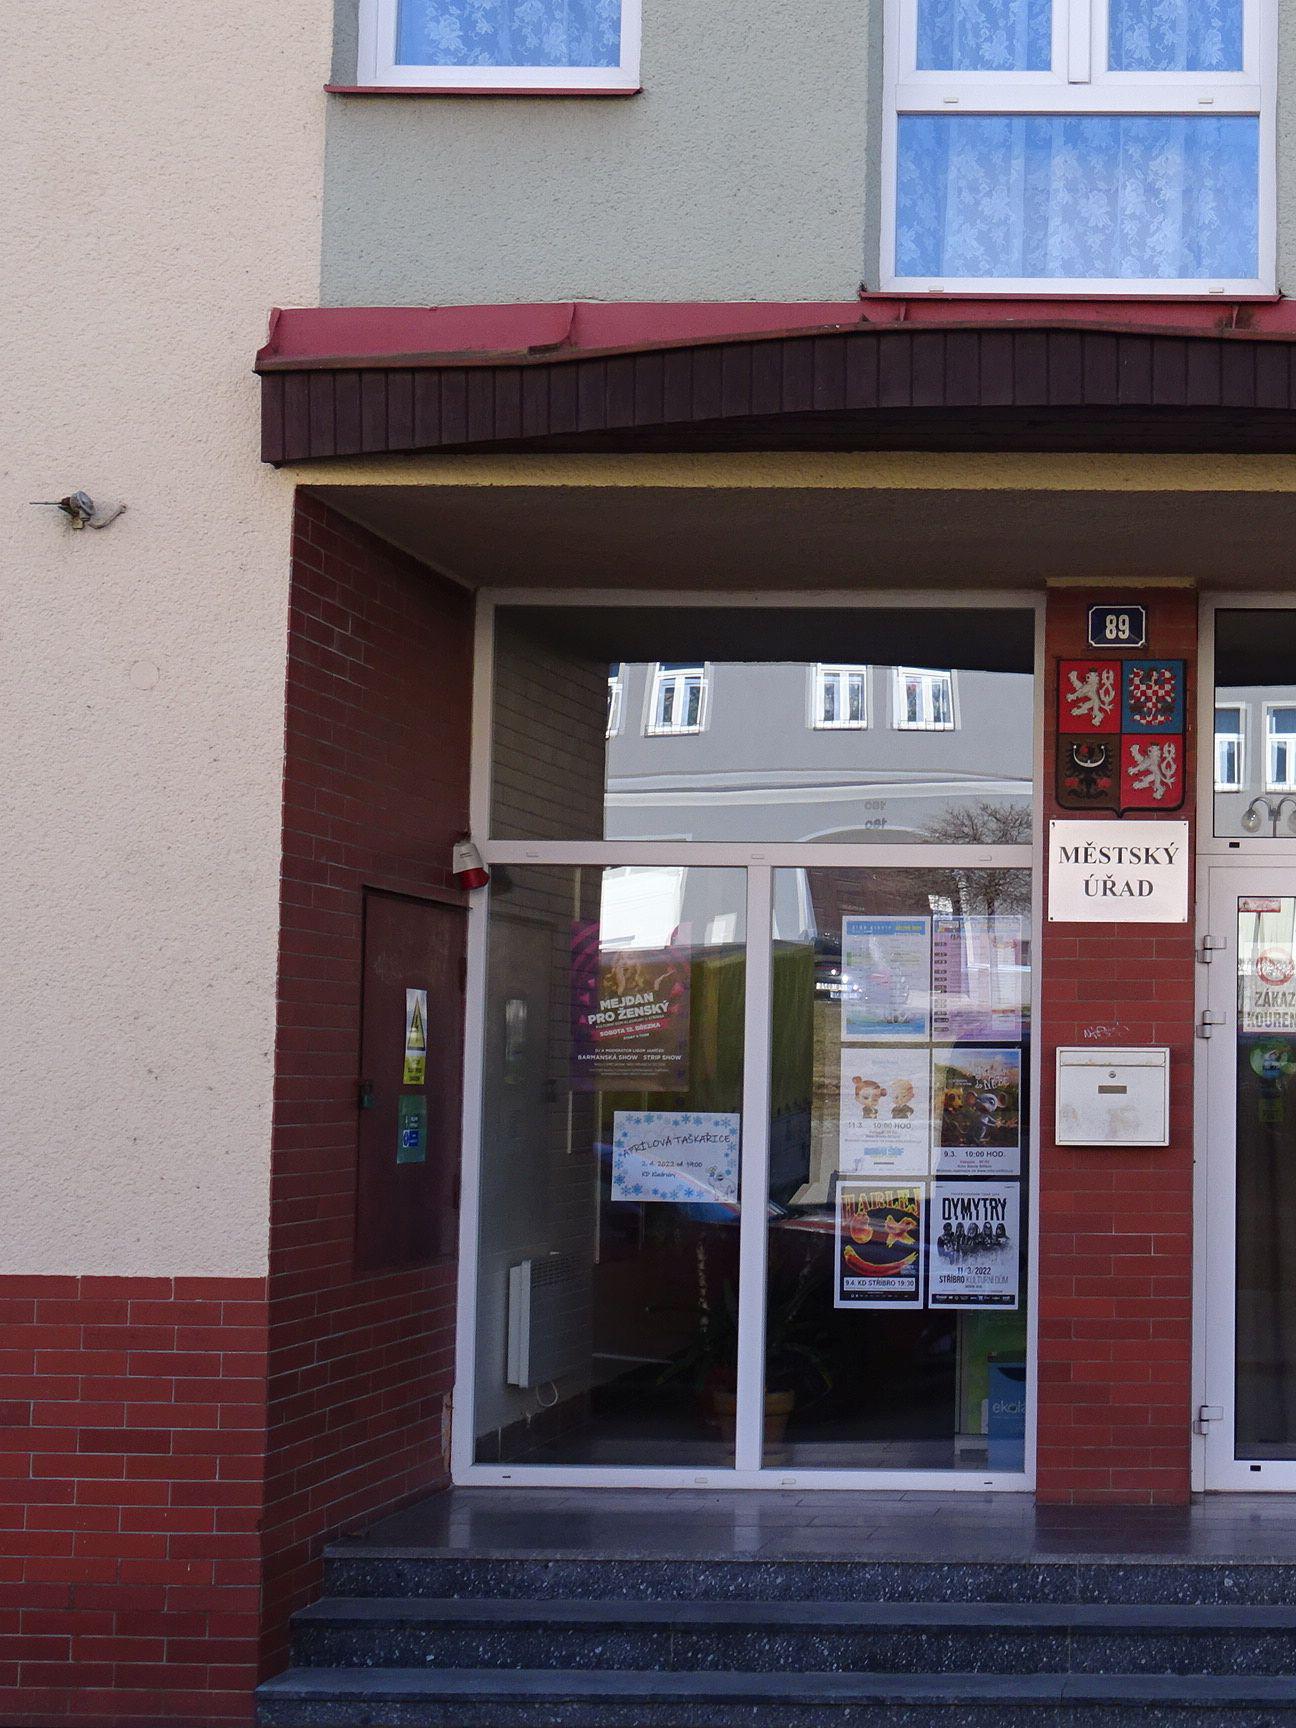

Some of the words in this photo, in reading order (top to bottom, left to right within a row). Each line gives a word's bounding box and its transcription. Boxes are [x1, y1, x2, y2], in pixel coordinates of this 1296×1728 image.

[1105, 614, 1130, 640] 89
[1058, 840, 1180, 866] MĚSTSKÝ
[1083, 873, 1154, 897] ÚŘAD
[599, 991, 654, 1011] MEJDAN
[1254, 988, 1296, 1008] ZÁKAZ
[587, 1011, 616, 1025] PRO
[618, 1000, 670, 1020] ŽENSKÝ
[942, 1197, 1008, 1222] DYMYTRY
[938, 1273, 965, 1284] STŘÍBRO
